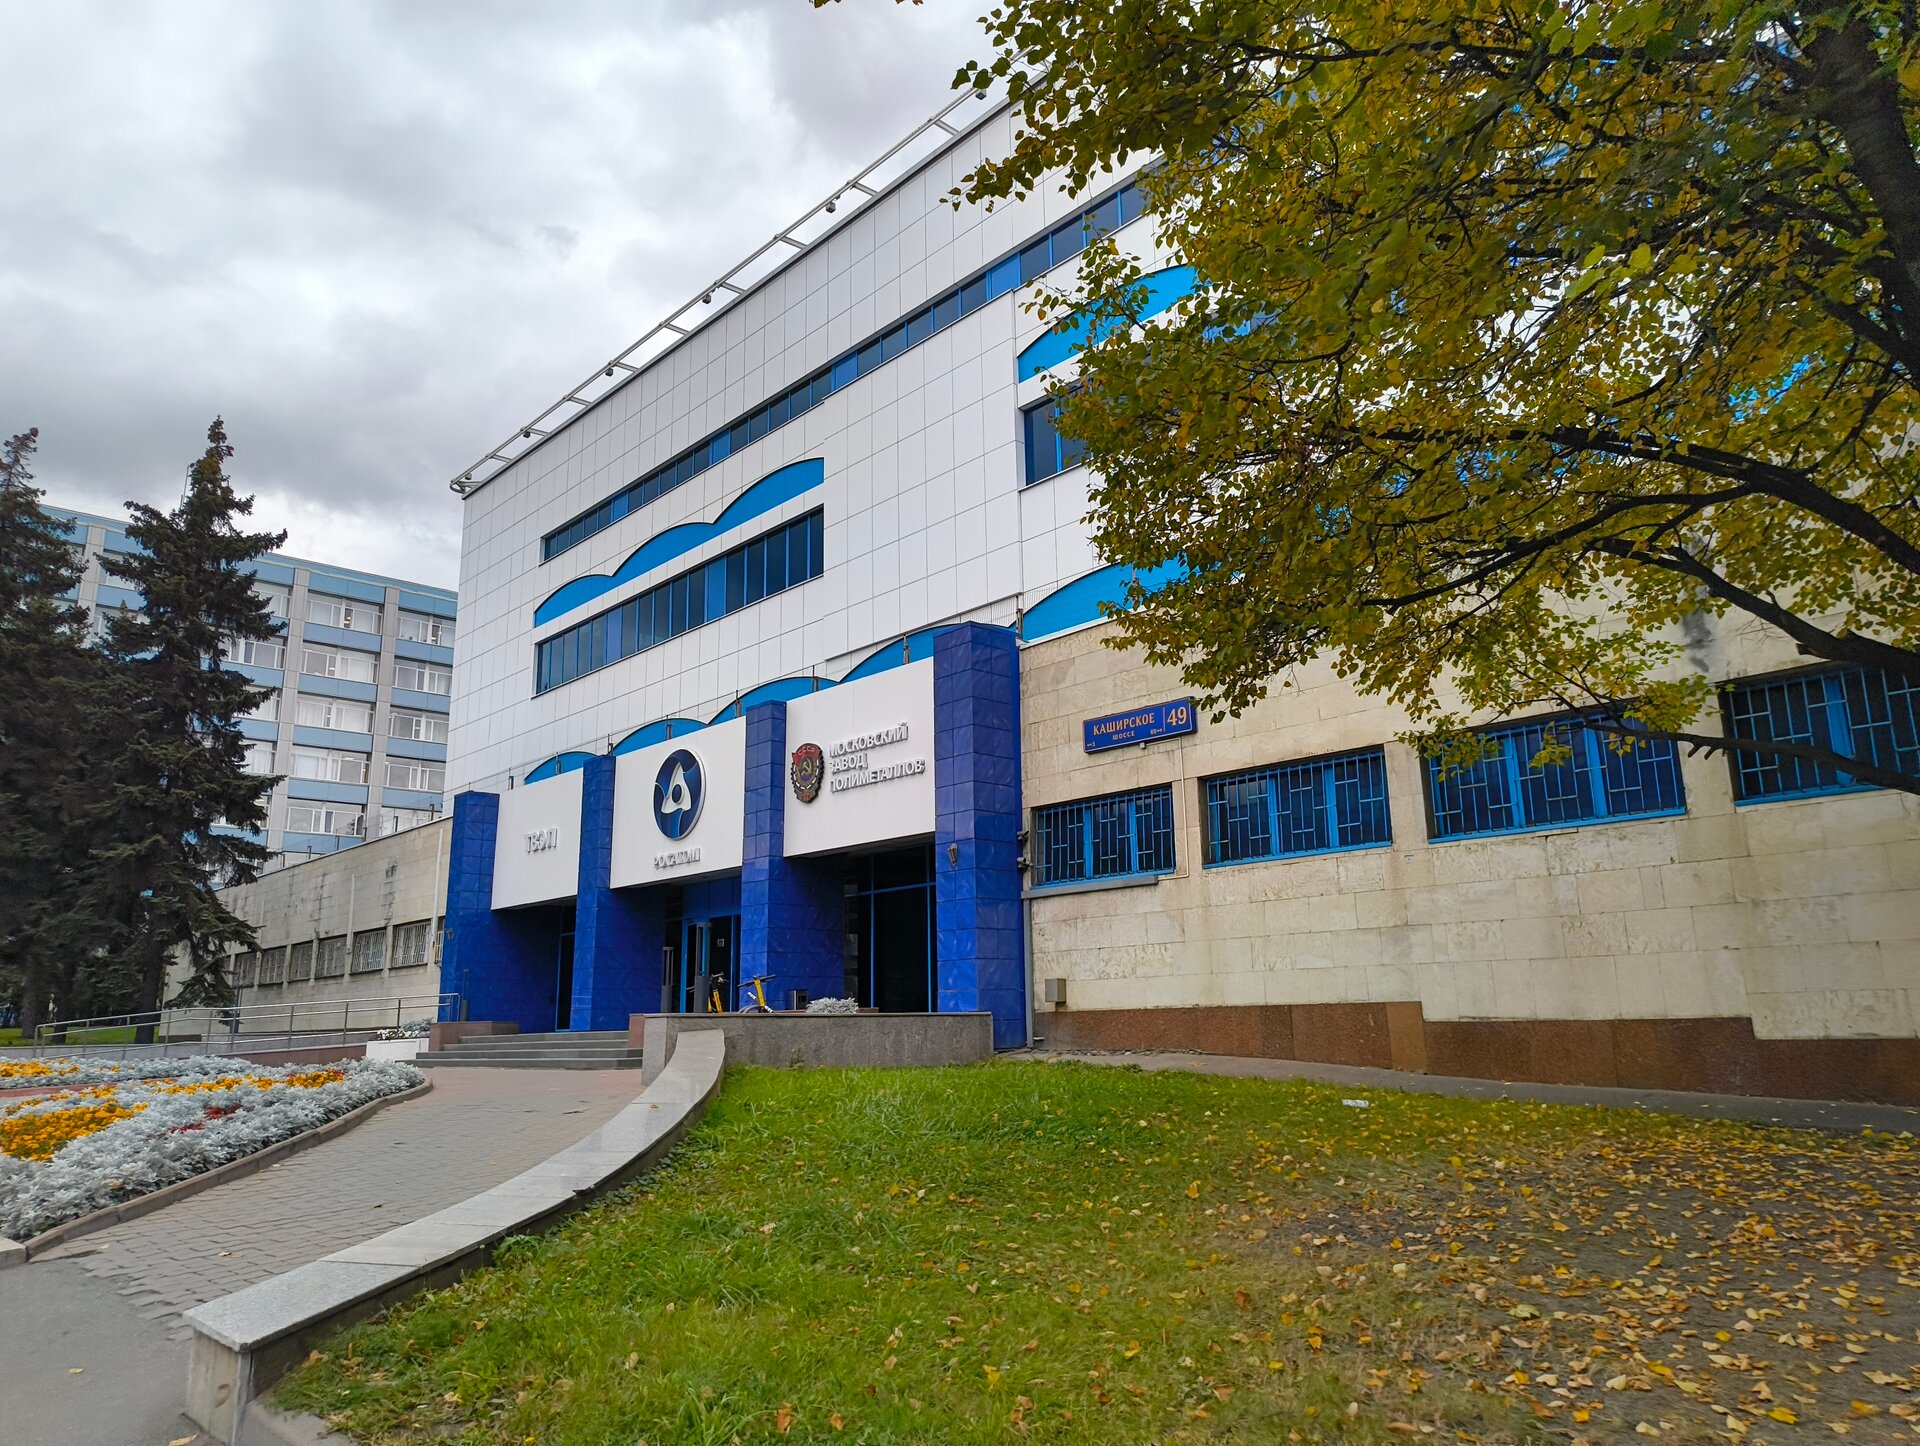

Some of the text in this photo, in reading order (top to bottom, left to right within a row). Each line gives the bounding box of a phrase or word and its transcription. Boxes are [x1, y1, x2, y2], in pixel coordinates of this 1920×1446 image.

[1093, 712, 1155, 735] КАШИРСКОЕ
[1167, 706, 1187, 727] 49
[829, 722, 909, 757] МОСКОВСКИЙ
[1112, 730, 1135, 741] ШОССЕ
[829, 752, 868, 774] ЗАВОД
[829, 759, 926, 793] ПОЛИМЕТАЛЛОВ
